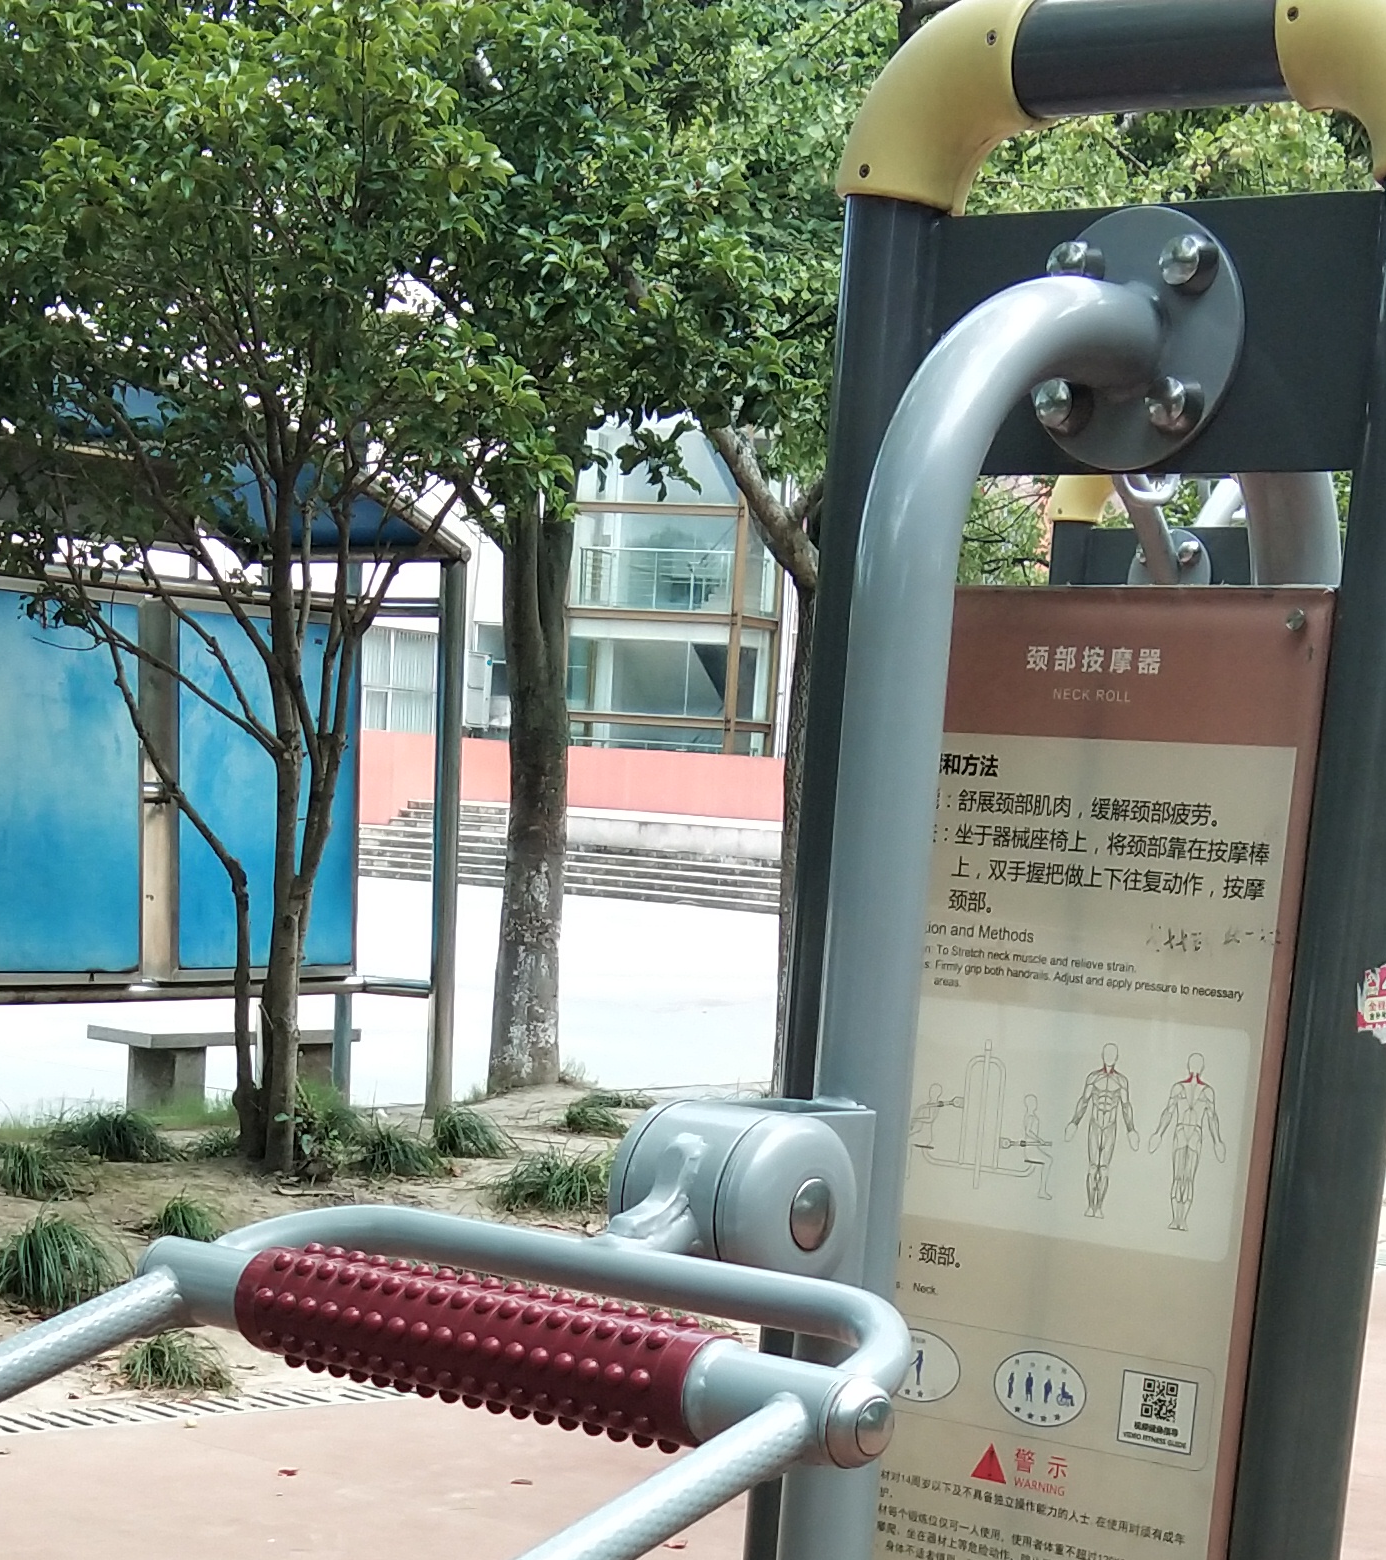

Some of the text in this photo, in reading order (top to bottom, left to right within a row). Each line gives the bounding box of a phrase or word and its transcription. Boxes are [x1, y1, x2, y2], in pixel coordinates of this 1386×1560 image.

[1026, 645, 1161, 674] 颈部按摩器
[1053, 688, 1131, 702] NECK ROLL
[939, 753, 998, 777] 和方法
[936, 788, 1217, 827] ：舒展颈部肌肉，缓解颈部疲劳。
[933, 823, 1270, 865] ：坐于器械座椅上，将颈部靠在按摩棒
[948, 889, 992, 913] 颈部。
[951, 926, 974, 938] and
[979, 925, 1034, 943] Methods
[937, 944, 948, 955] To
[952, 945, 984, 958] Stretch
[988, 951, 1010, 961] neck
[1013, 954, 1046, 964] muscle
[1050, 957, 1068, 967] and
[1107, 963, 1136, 973] strain.
[935, 960, 962, 974] Firmly
[965, 965, 982, 975] grip
[984, 966, 1004, 976] both
[1054, 971, 1083, 985] Adjust
[1086, 976, 1104, 986] and
[1107, 979, 1132, 991] apply
[1135, 982, 1177, 994] pressure
[1180, 985, 1190, 995] to
[1192, 987, 1244, 1002] necessary
[1143, 1435, 1165, 1444] FITNESS
[1015, 1448, 1068, 1479] 警示
[1014, 1477, 1065, 1497] WARNING
